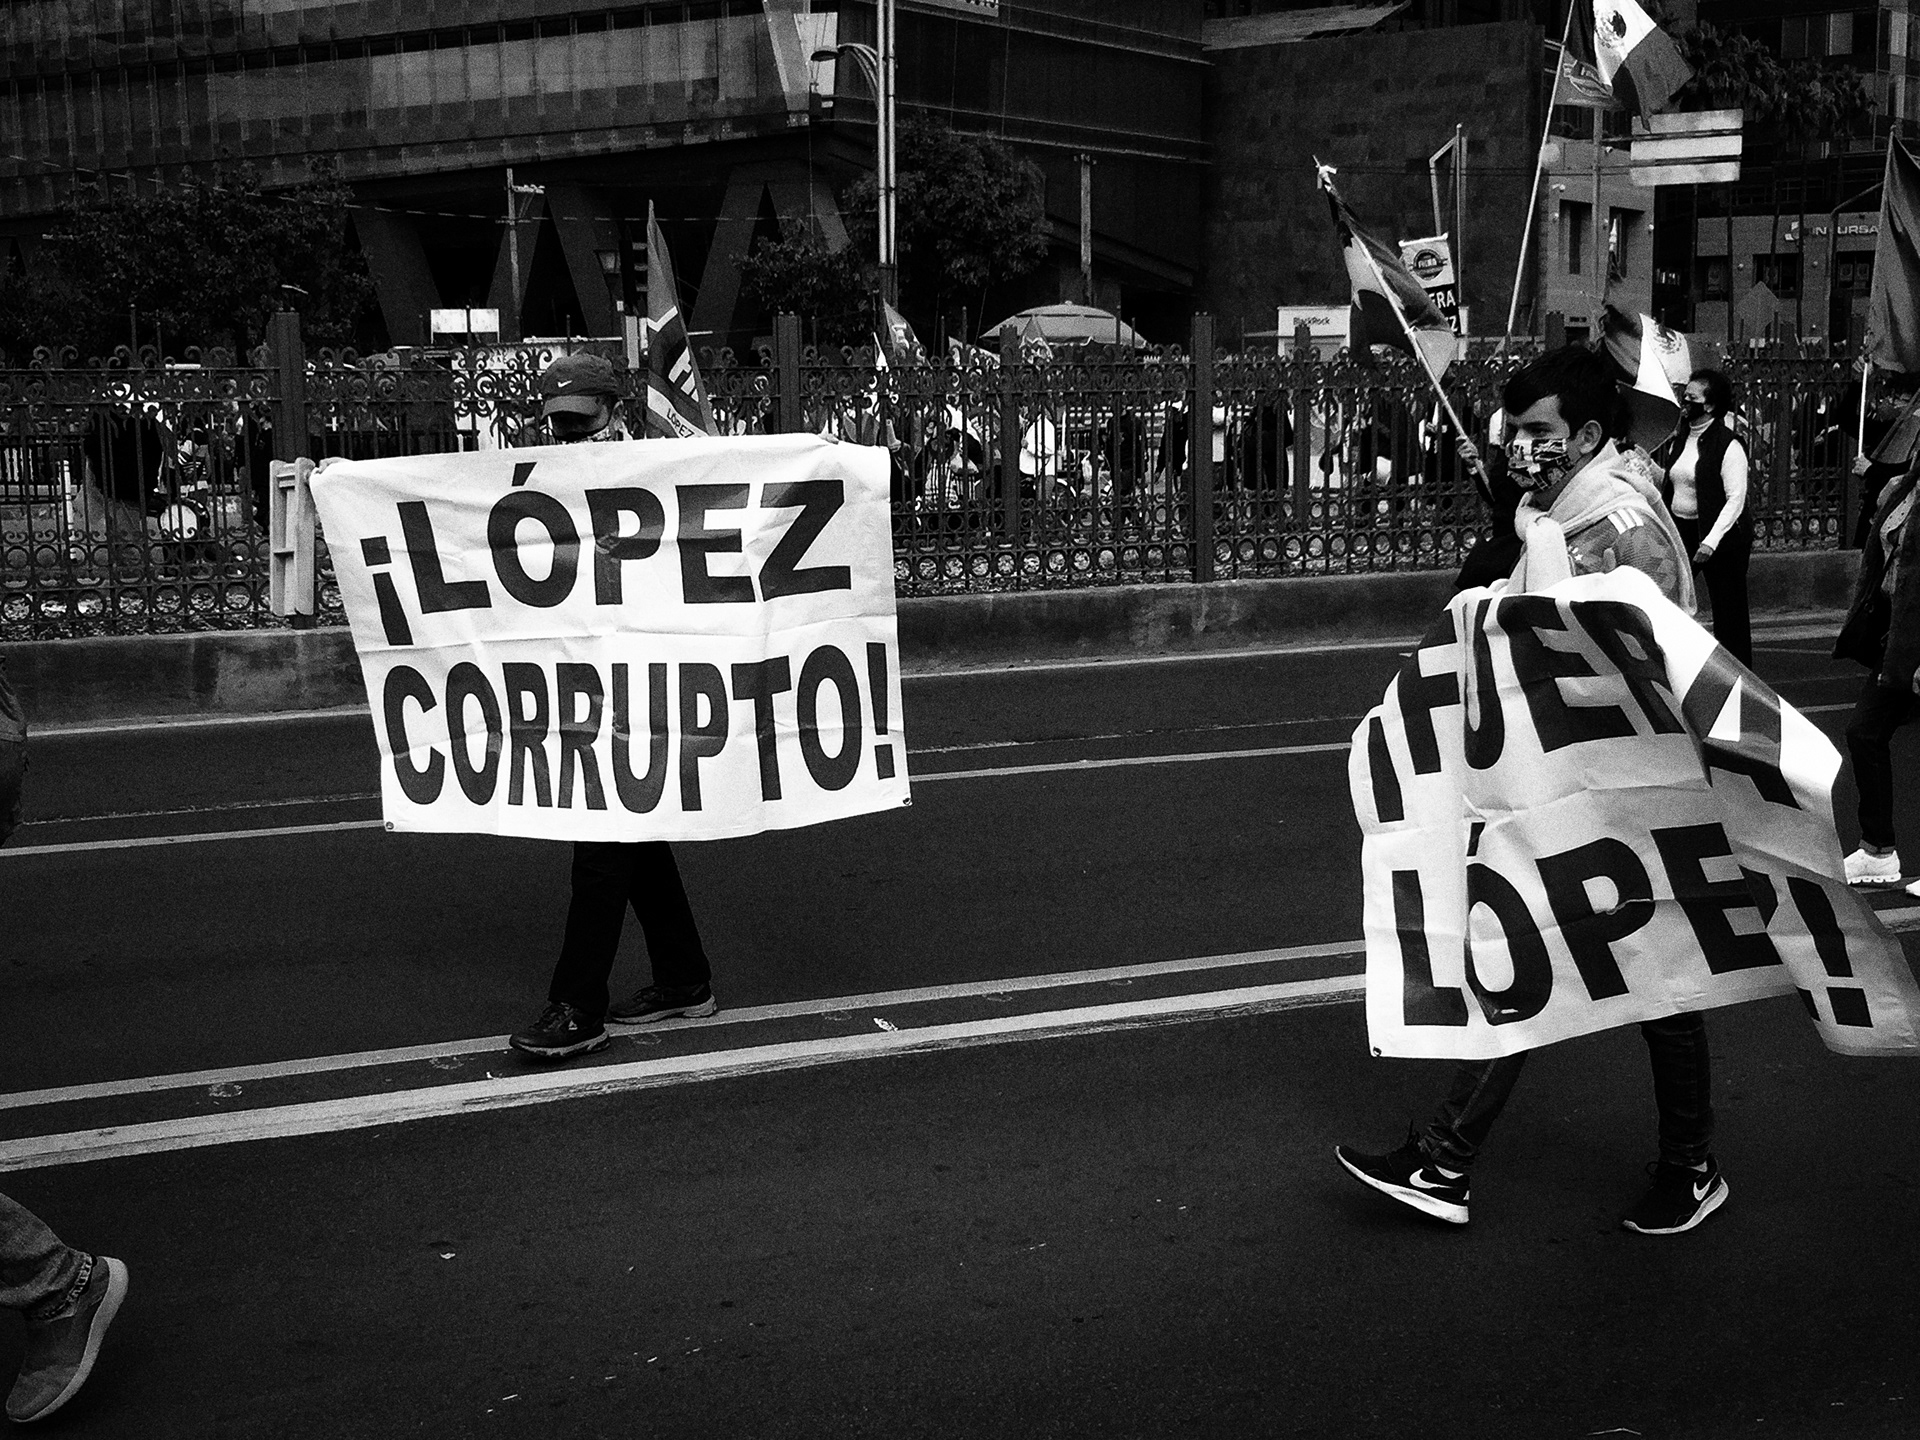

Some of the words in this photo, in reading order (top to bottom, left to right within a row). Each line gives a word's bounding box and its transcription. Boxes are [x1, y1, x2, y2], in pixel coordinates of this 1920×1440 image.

[1812, 225, 1879, 236] INURSA
[360, 461, 852, 646] ¡LÓPEZ
[383, 641, 896, 814] CORRUPTO!
